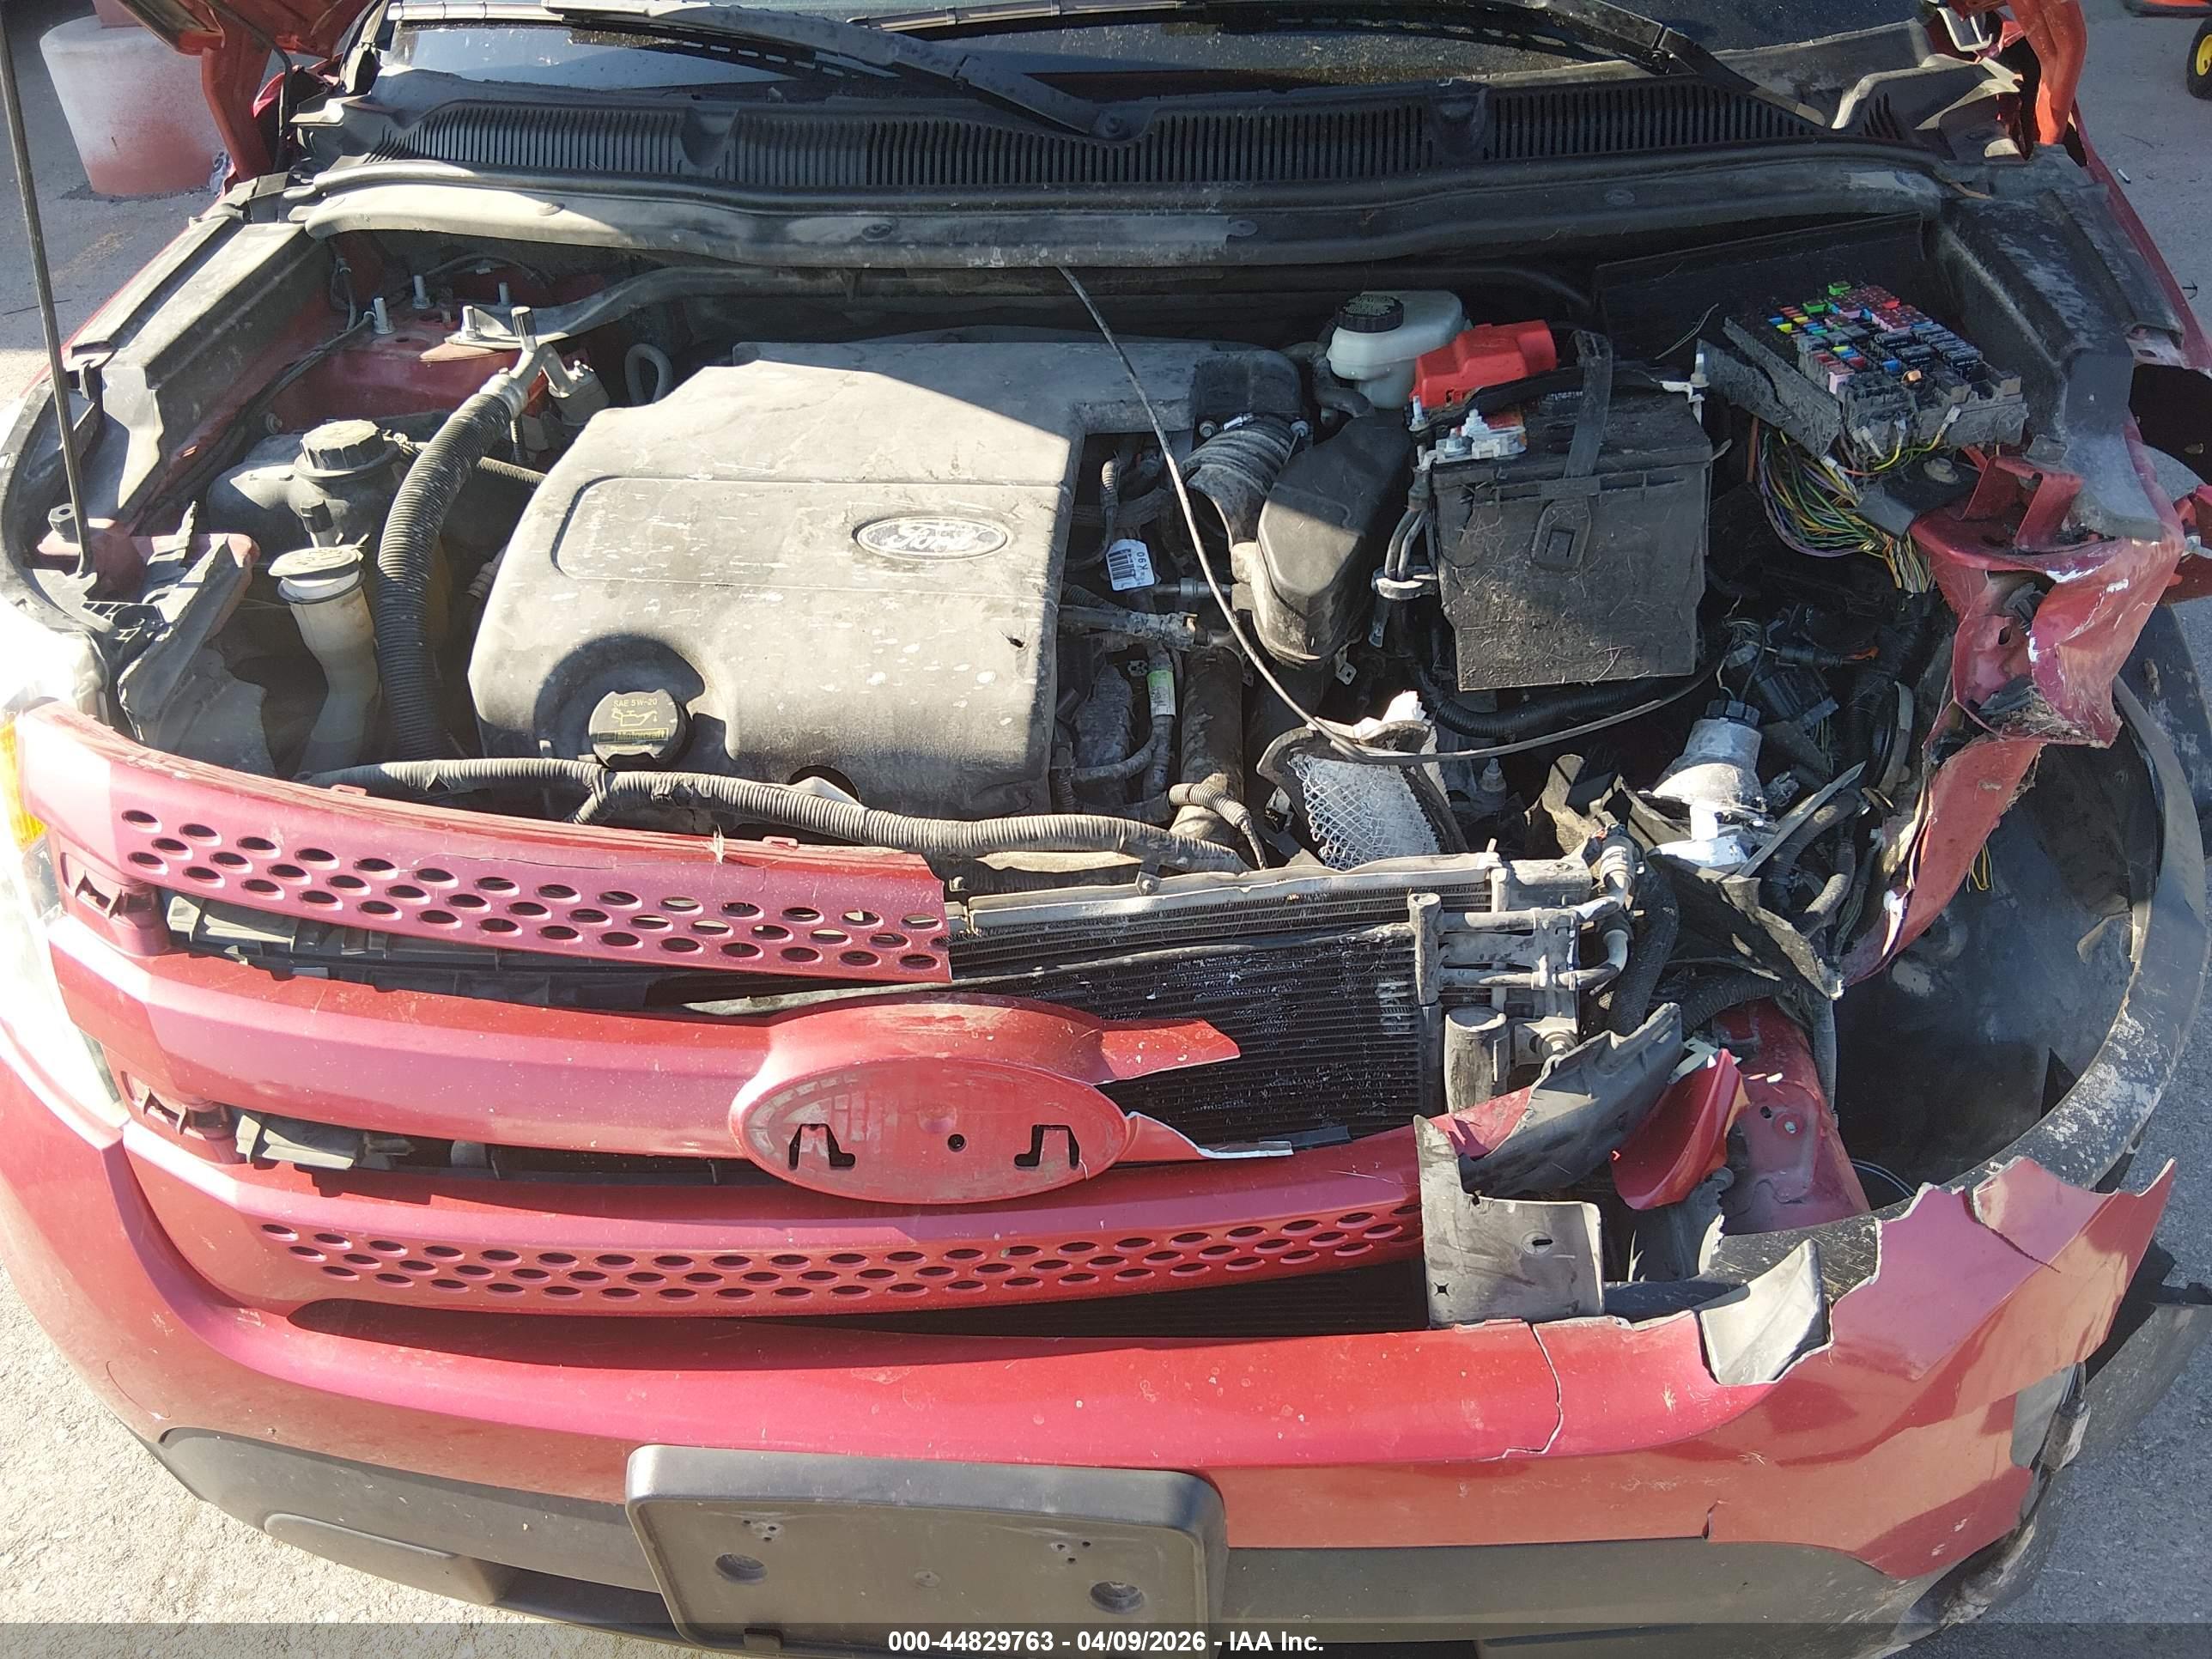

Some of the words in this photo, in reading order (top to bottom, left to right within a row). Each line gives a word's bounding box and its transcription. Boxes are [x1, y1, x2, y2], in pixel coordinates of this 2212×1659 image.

[881, 521, 999, 552] Ford
[1136, 551, 1149, 570] K90
[613, 698, 630, 708] SAE
[630, 697, 659, 707] 5W-20
